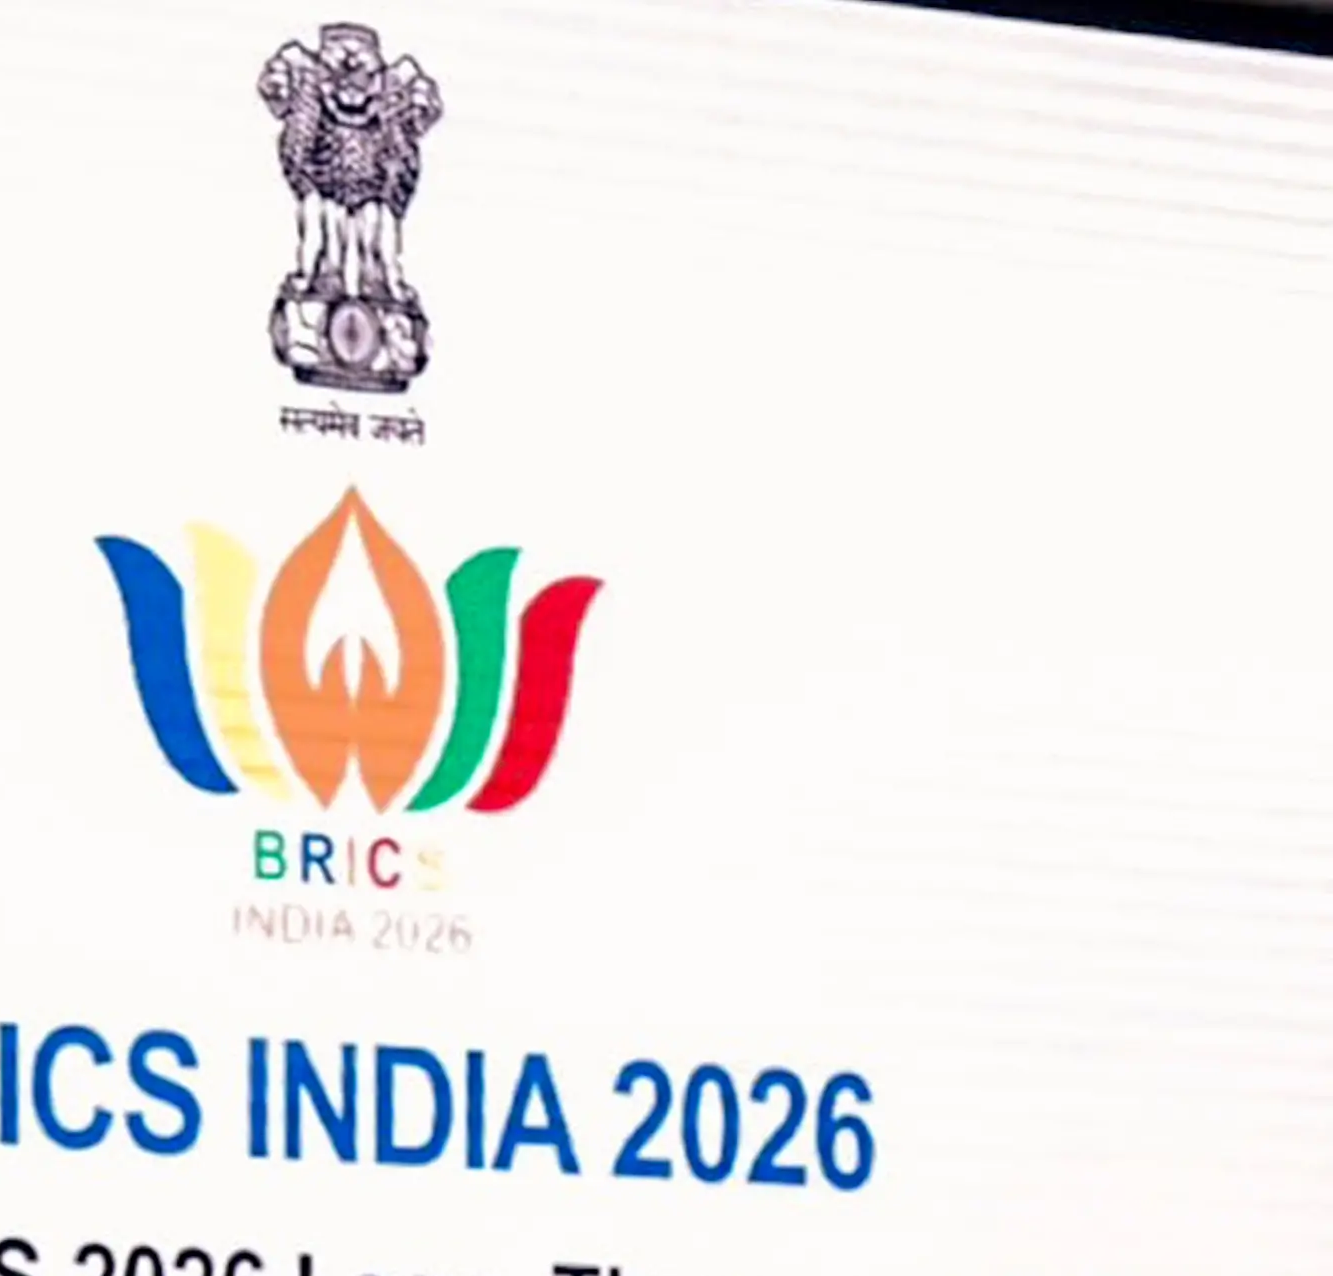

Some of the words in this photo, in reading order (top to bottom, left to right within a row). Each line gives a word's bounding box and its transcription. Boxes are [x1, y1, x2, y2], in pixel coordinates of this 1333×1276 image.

[252, 828, 445, 891] BRICS
[232, 903, 356, 944] INDIA
[371, 909, 473, 954] 2026
[248, 1037, 581, 1175] INDIA
[612, 1060, 875, 1192] 2026
